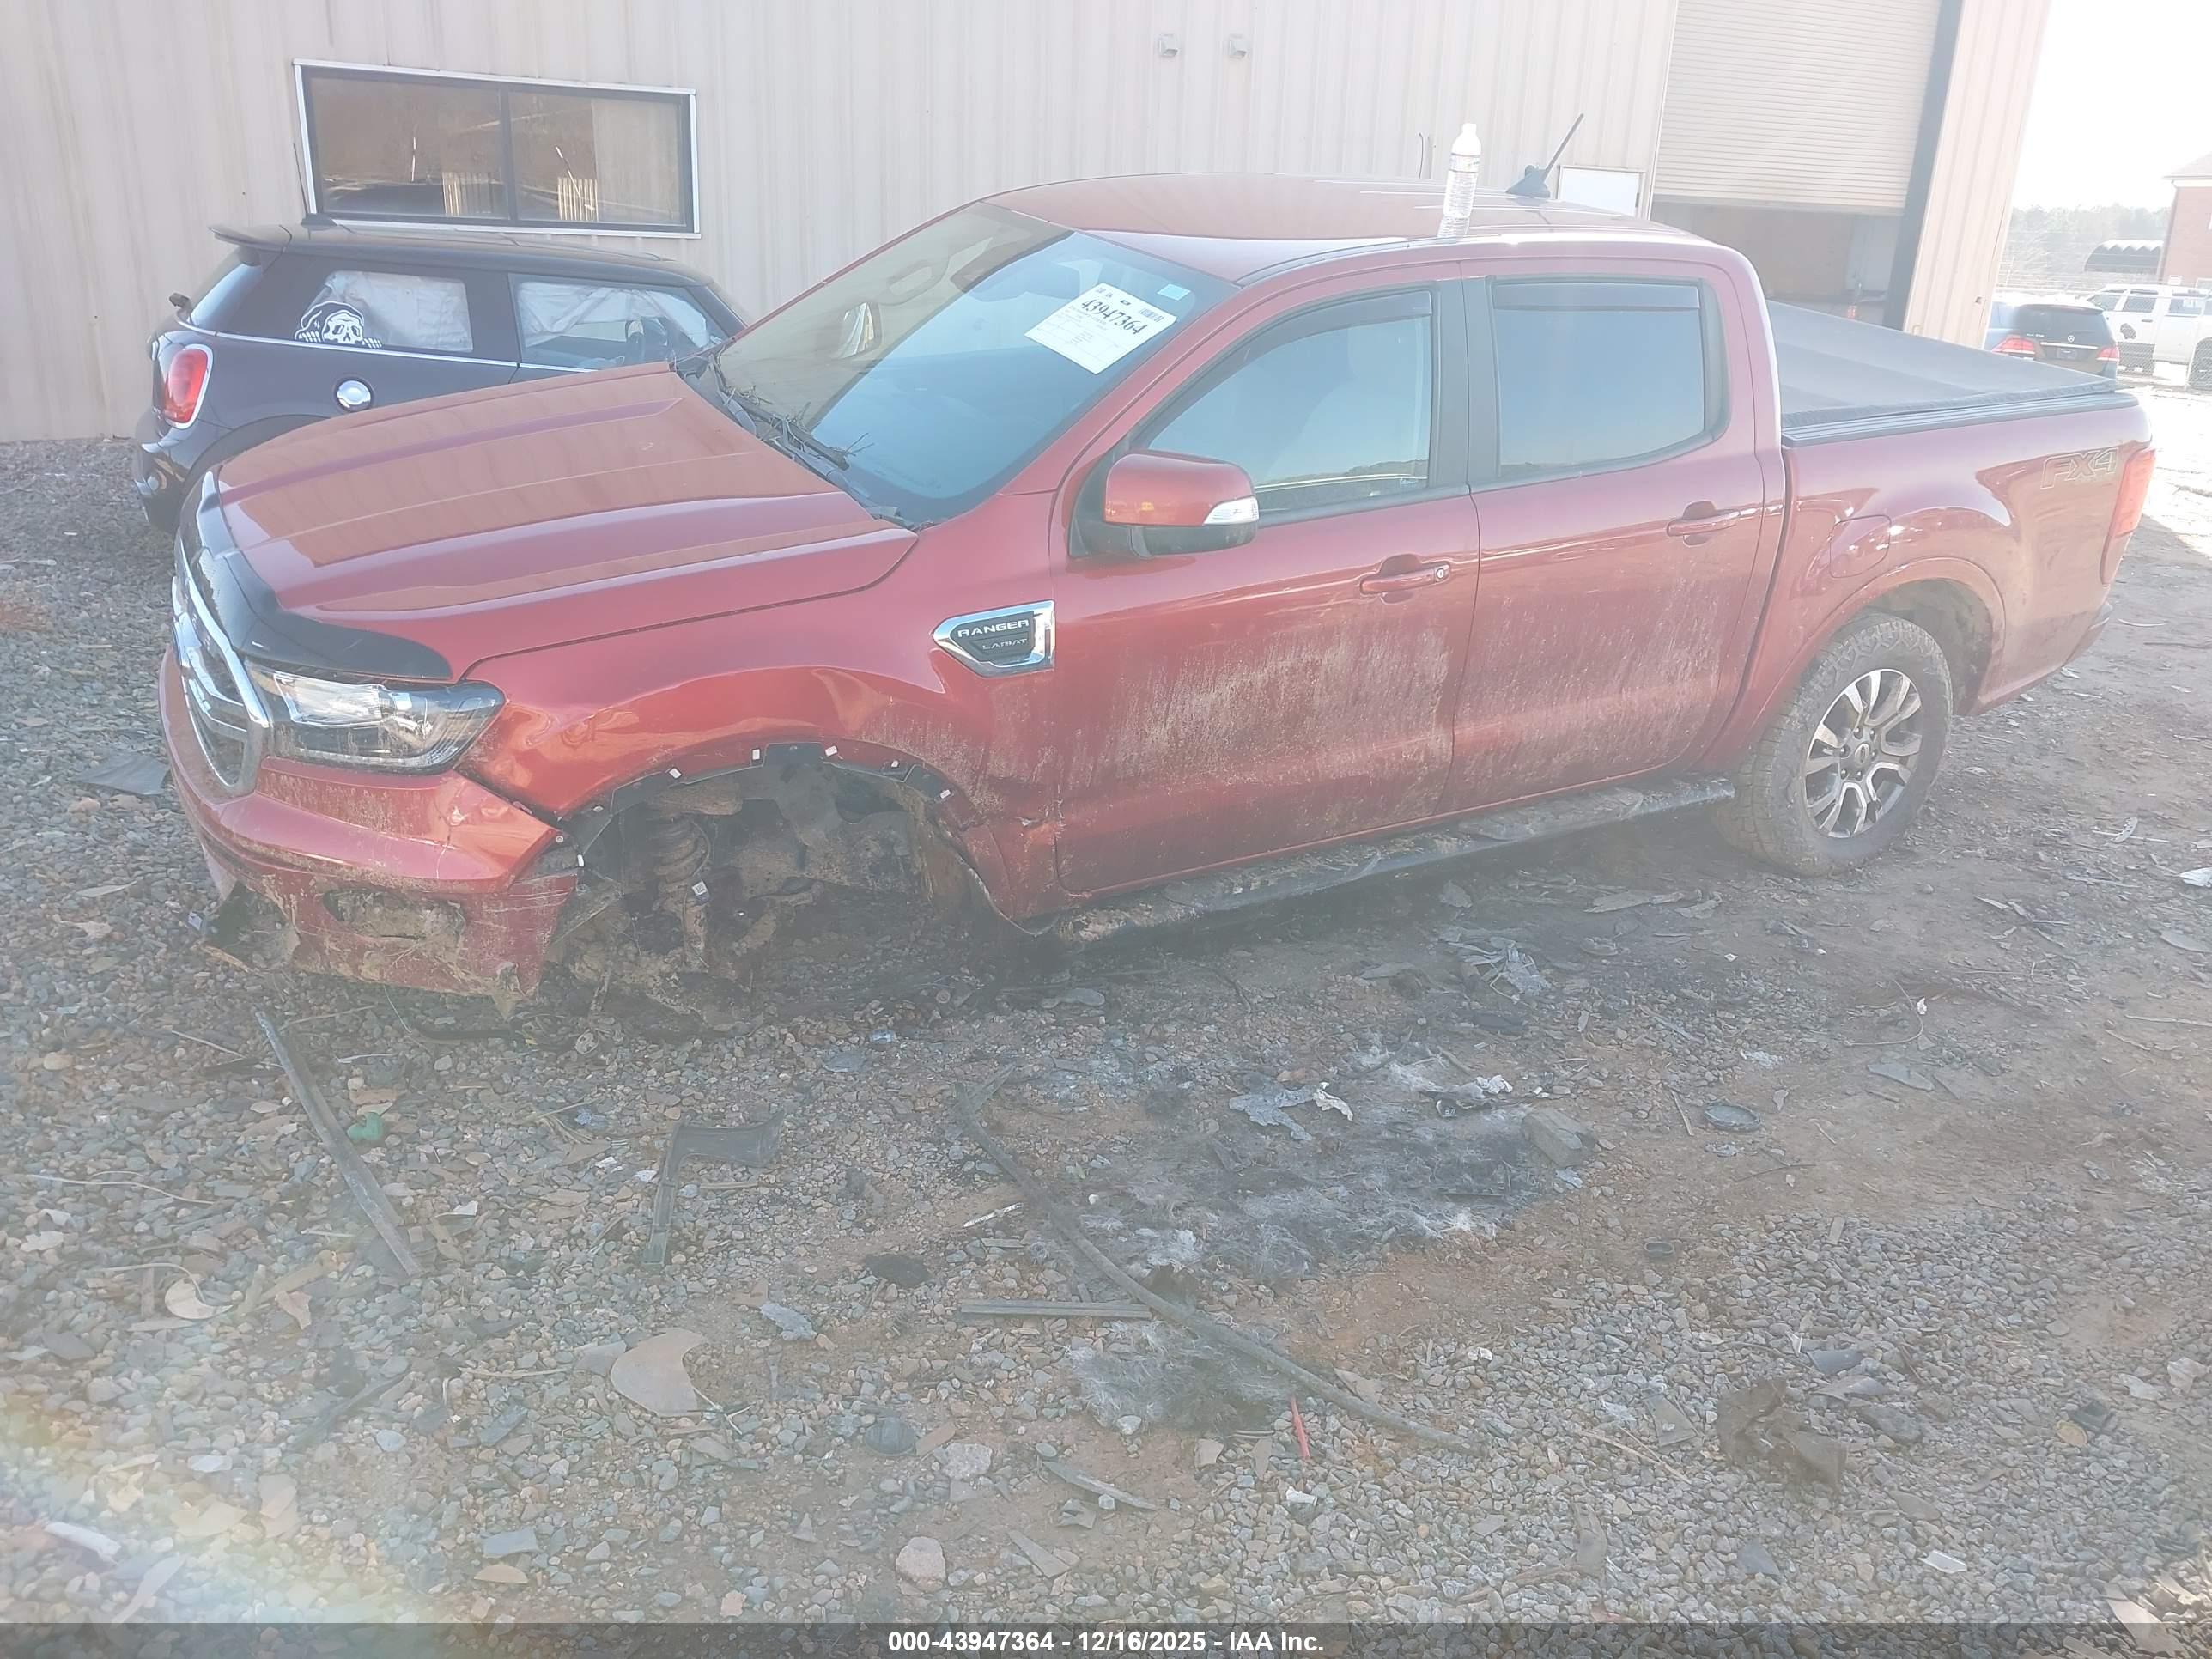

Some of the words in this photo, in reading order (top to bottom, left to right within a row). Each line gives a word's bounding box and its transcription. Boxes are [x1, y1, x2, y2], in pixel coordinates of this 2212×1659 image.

[1080, 298, 1148, 335] 43947364
[2039, 447, 2120, 490] FX4
[957, 618, 1030, 638] RANGER
[981, 637, 1029, 651] LARIAT
